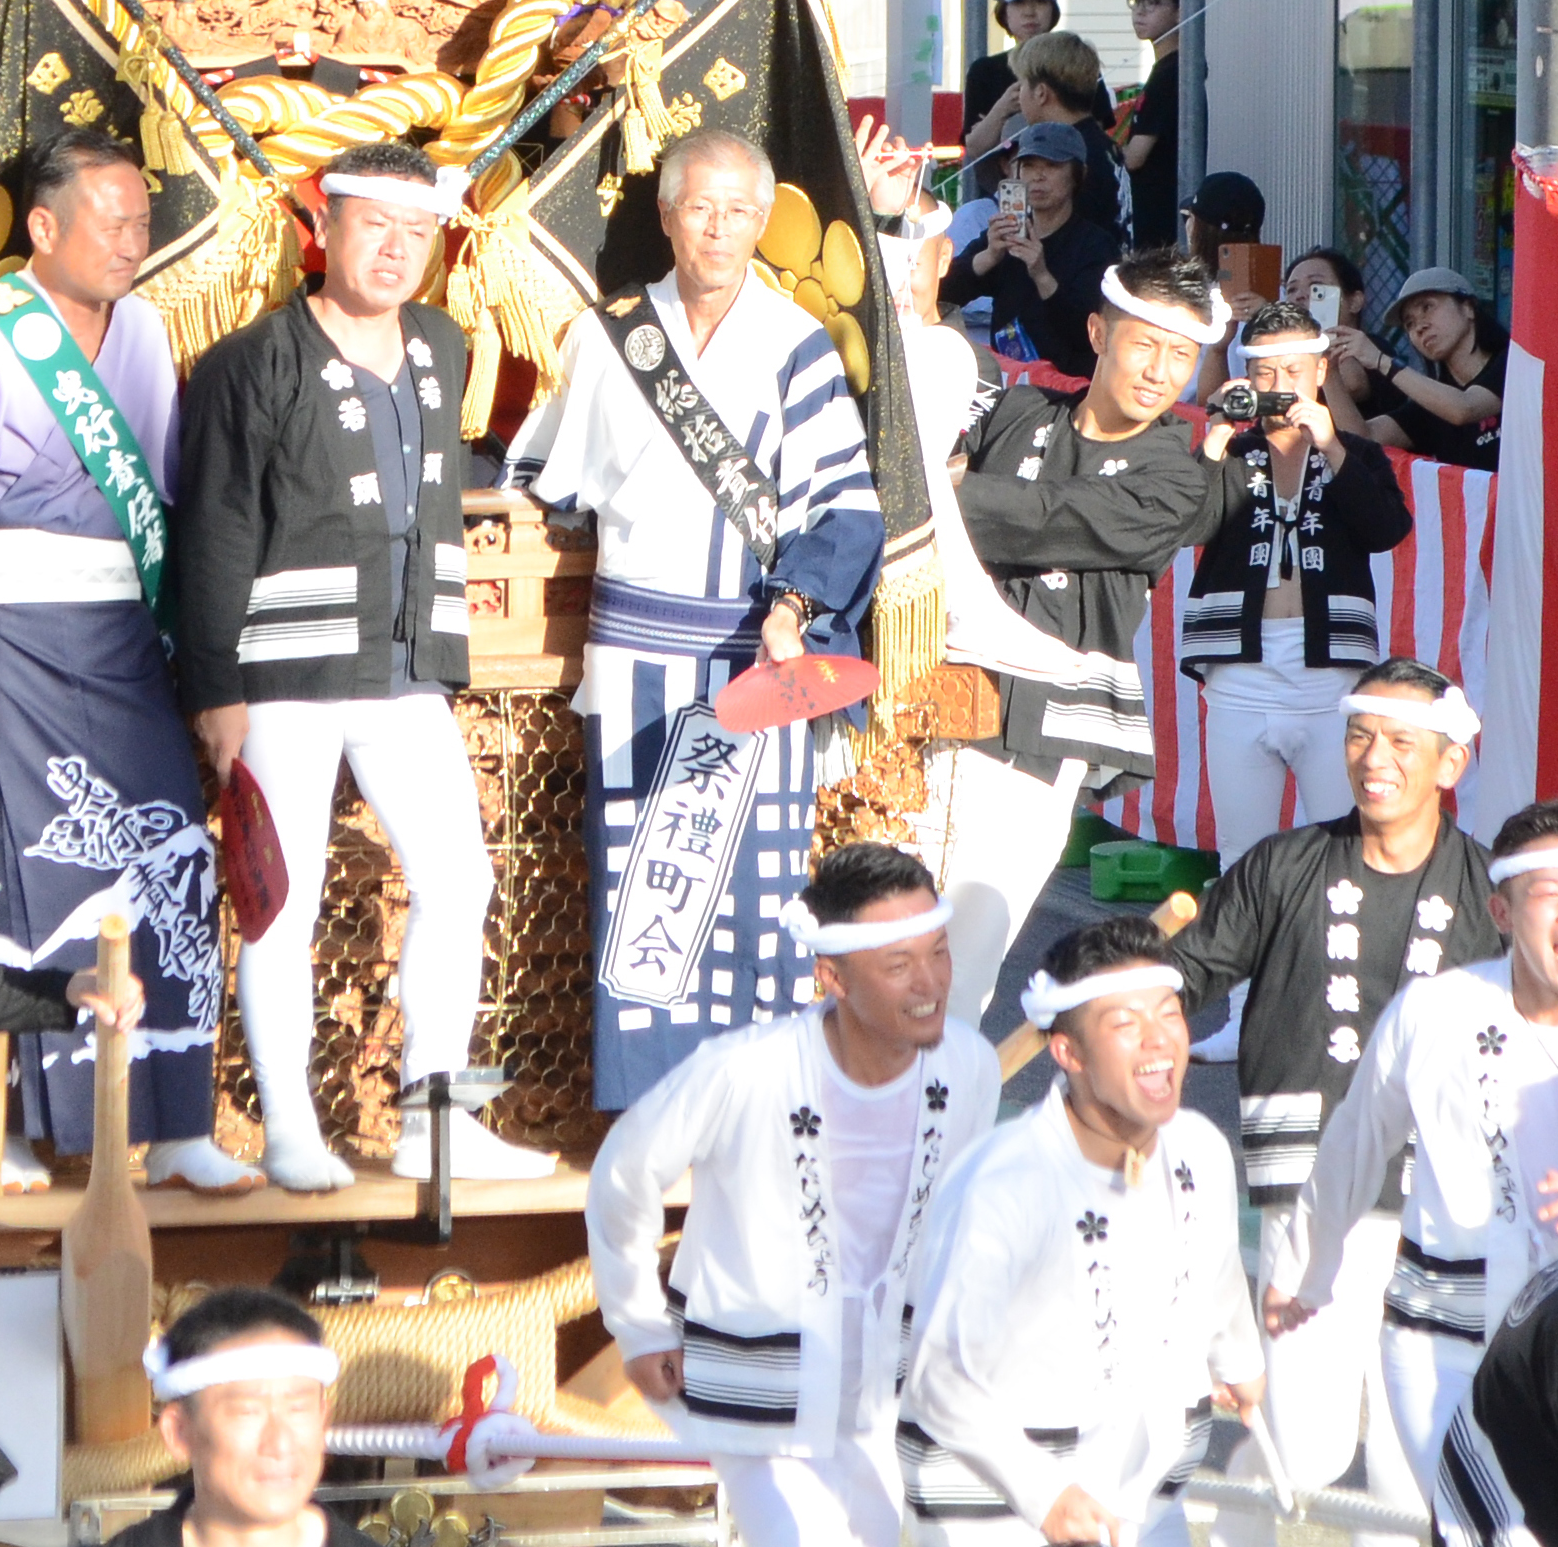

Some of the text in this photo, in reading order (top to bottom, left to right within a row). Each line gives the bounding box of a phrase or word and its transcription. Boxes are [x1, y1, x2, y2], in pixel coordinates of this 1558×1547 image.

[1245, 471, 1275, 568] 青年團
[1298, 472, 1326, 573] 青年團
[626, 730, 742, 978] 祭禮町会
